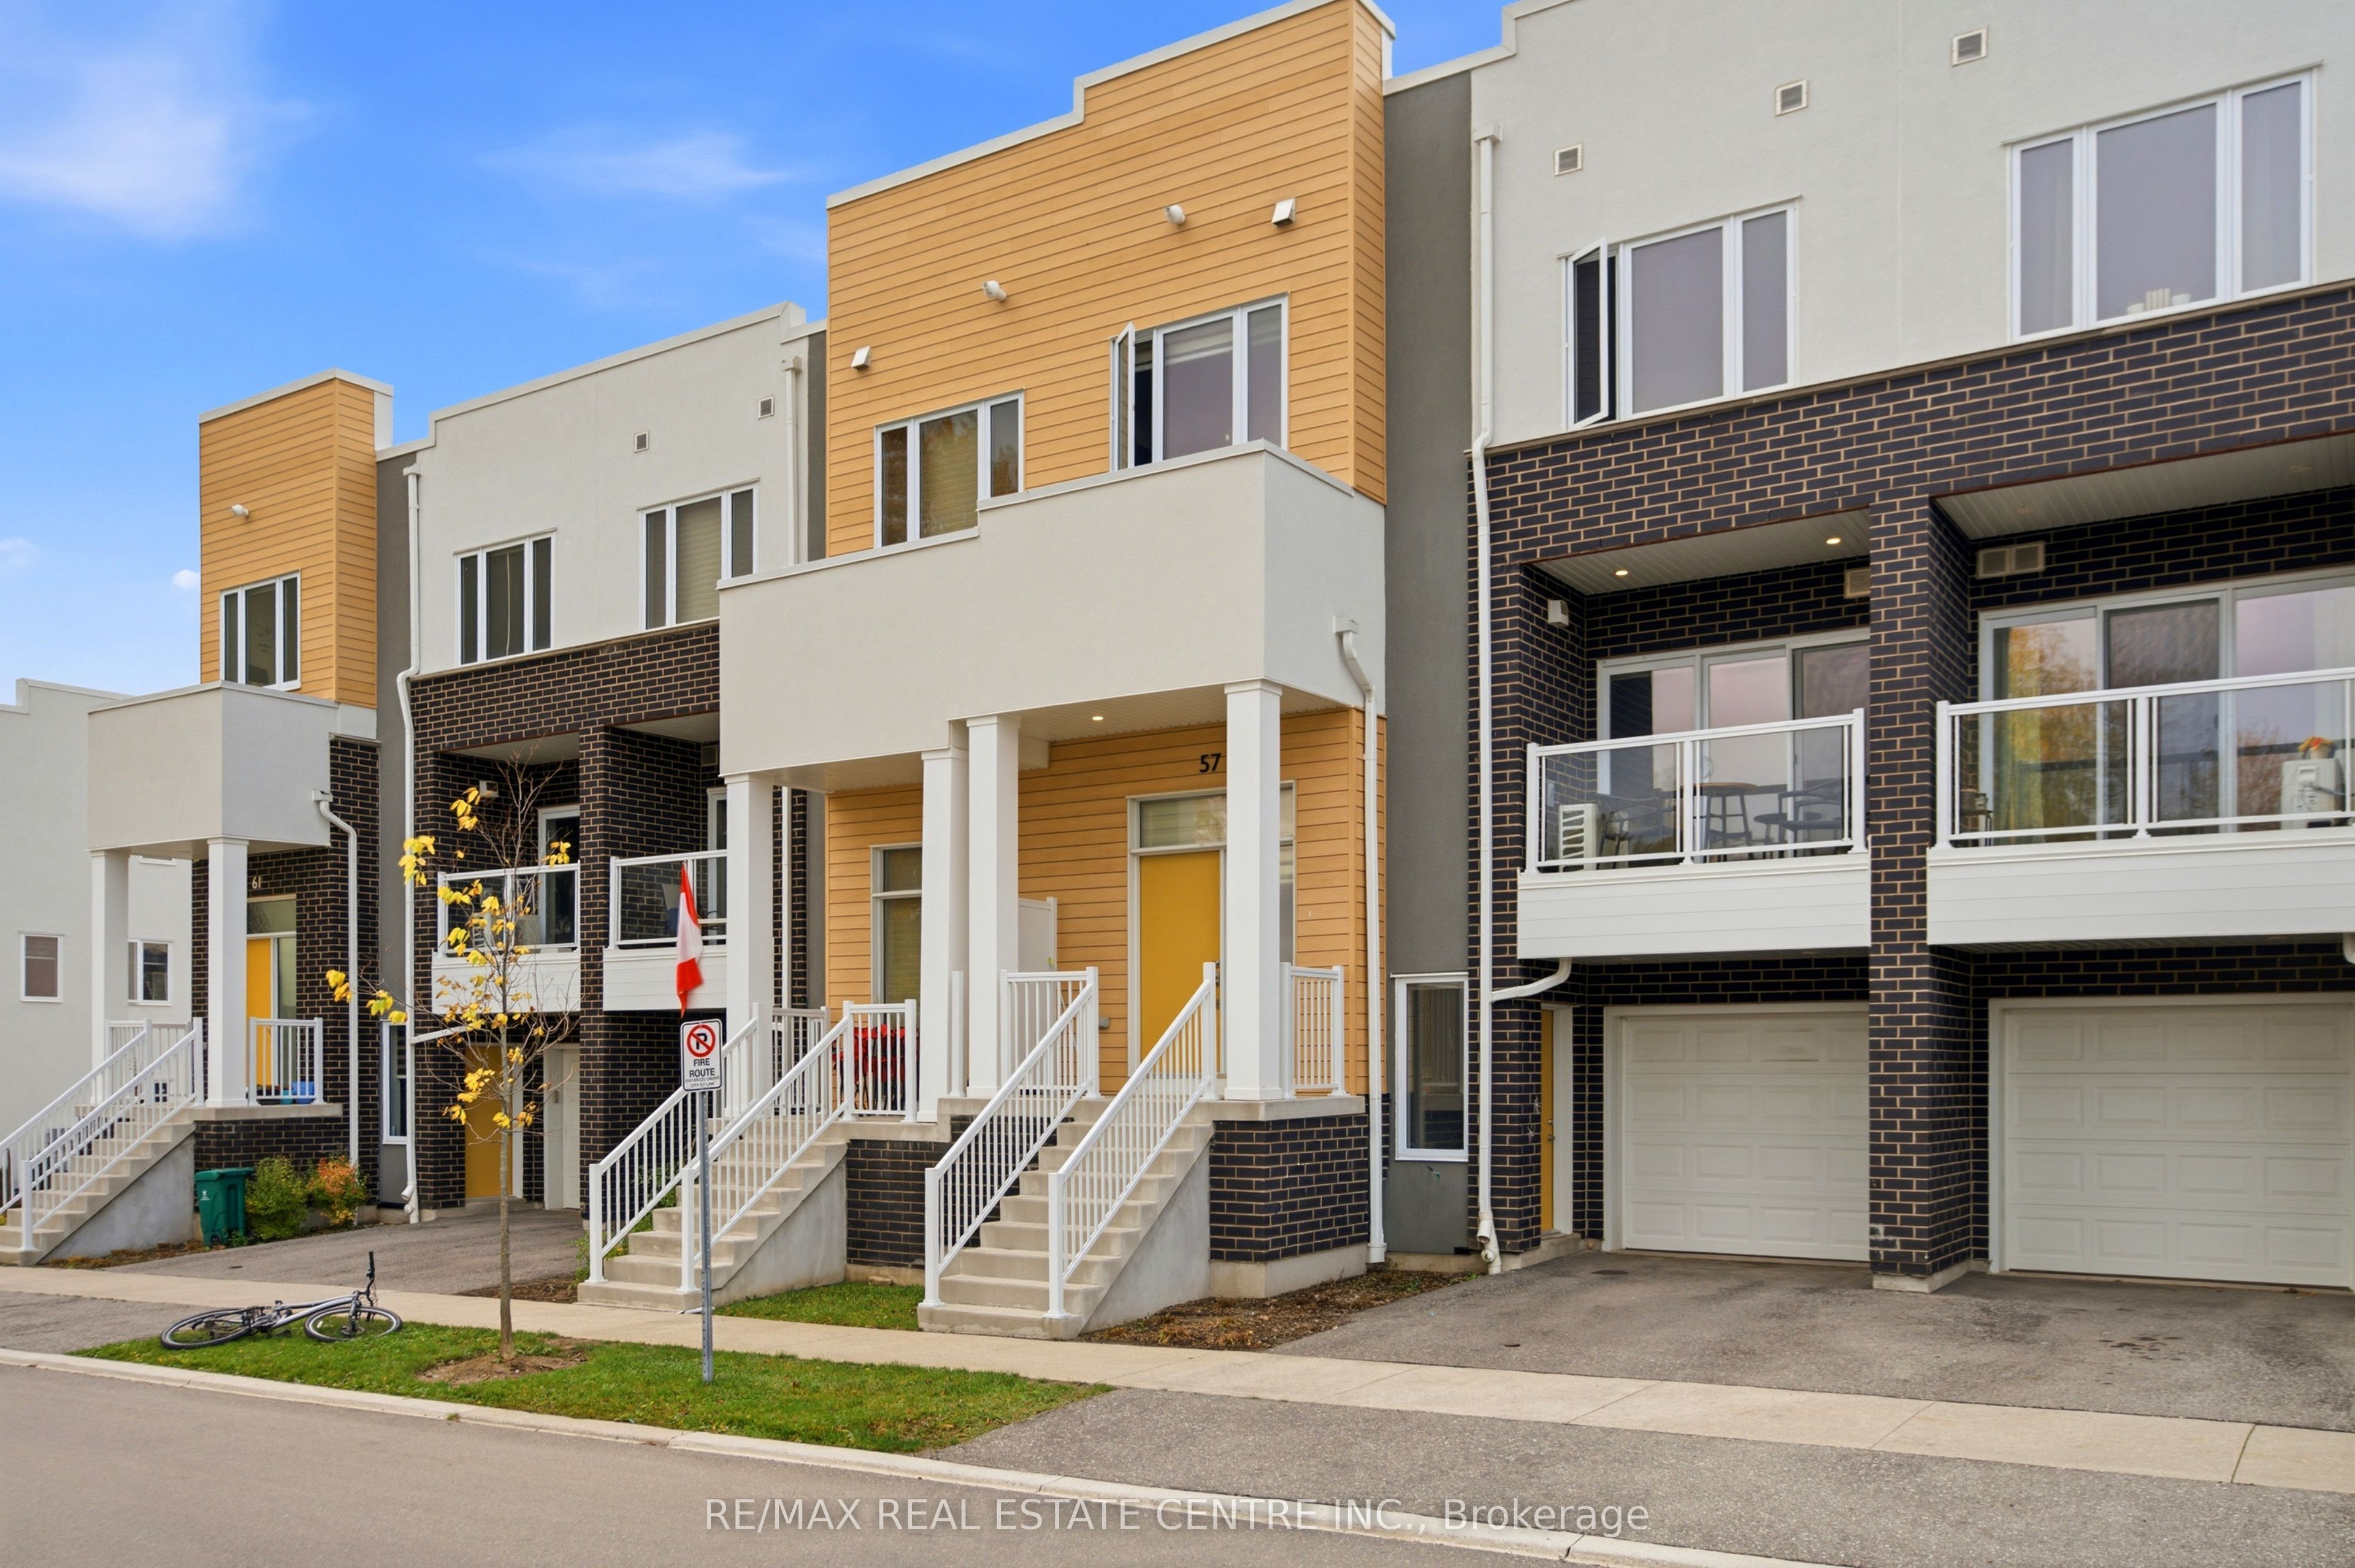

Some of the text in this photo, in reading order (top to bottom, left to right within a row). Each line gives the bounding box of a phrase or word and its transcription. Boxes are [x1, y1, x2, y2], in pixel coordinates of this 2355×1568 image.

[1199, 752, 1222, 773] 57
[252, 876, 261, 889] 61
[694, 1058, 710, 1066] FIRE
[689, 1068, 715, 1077] ROUTE
